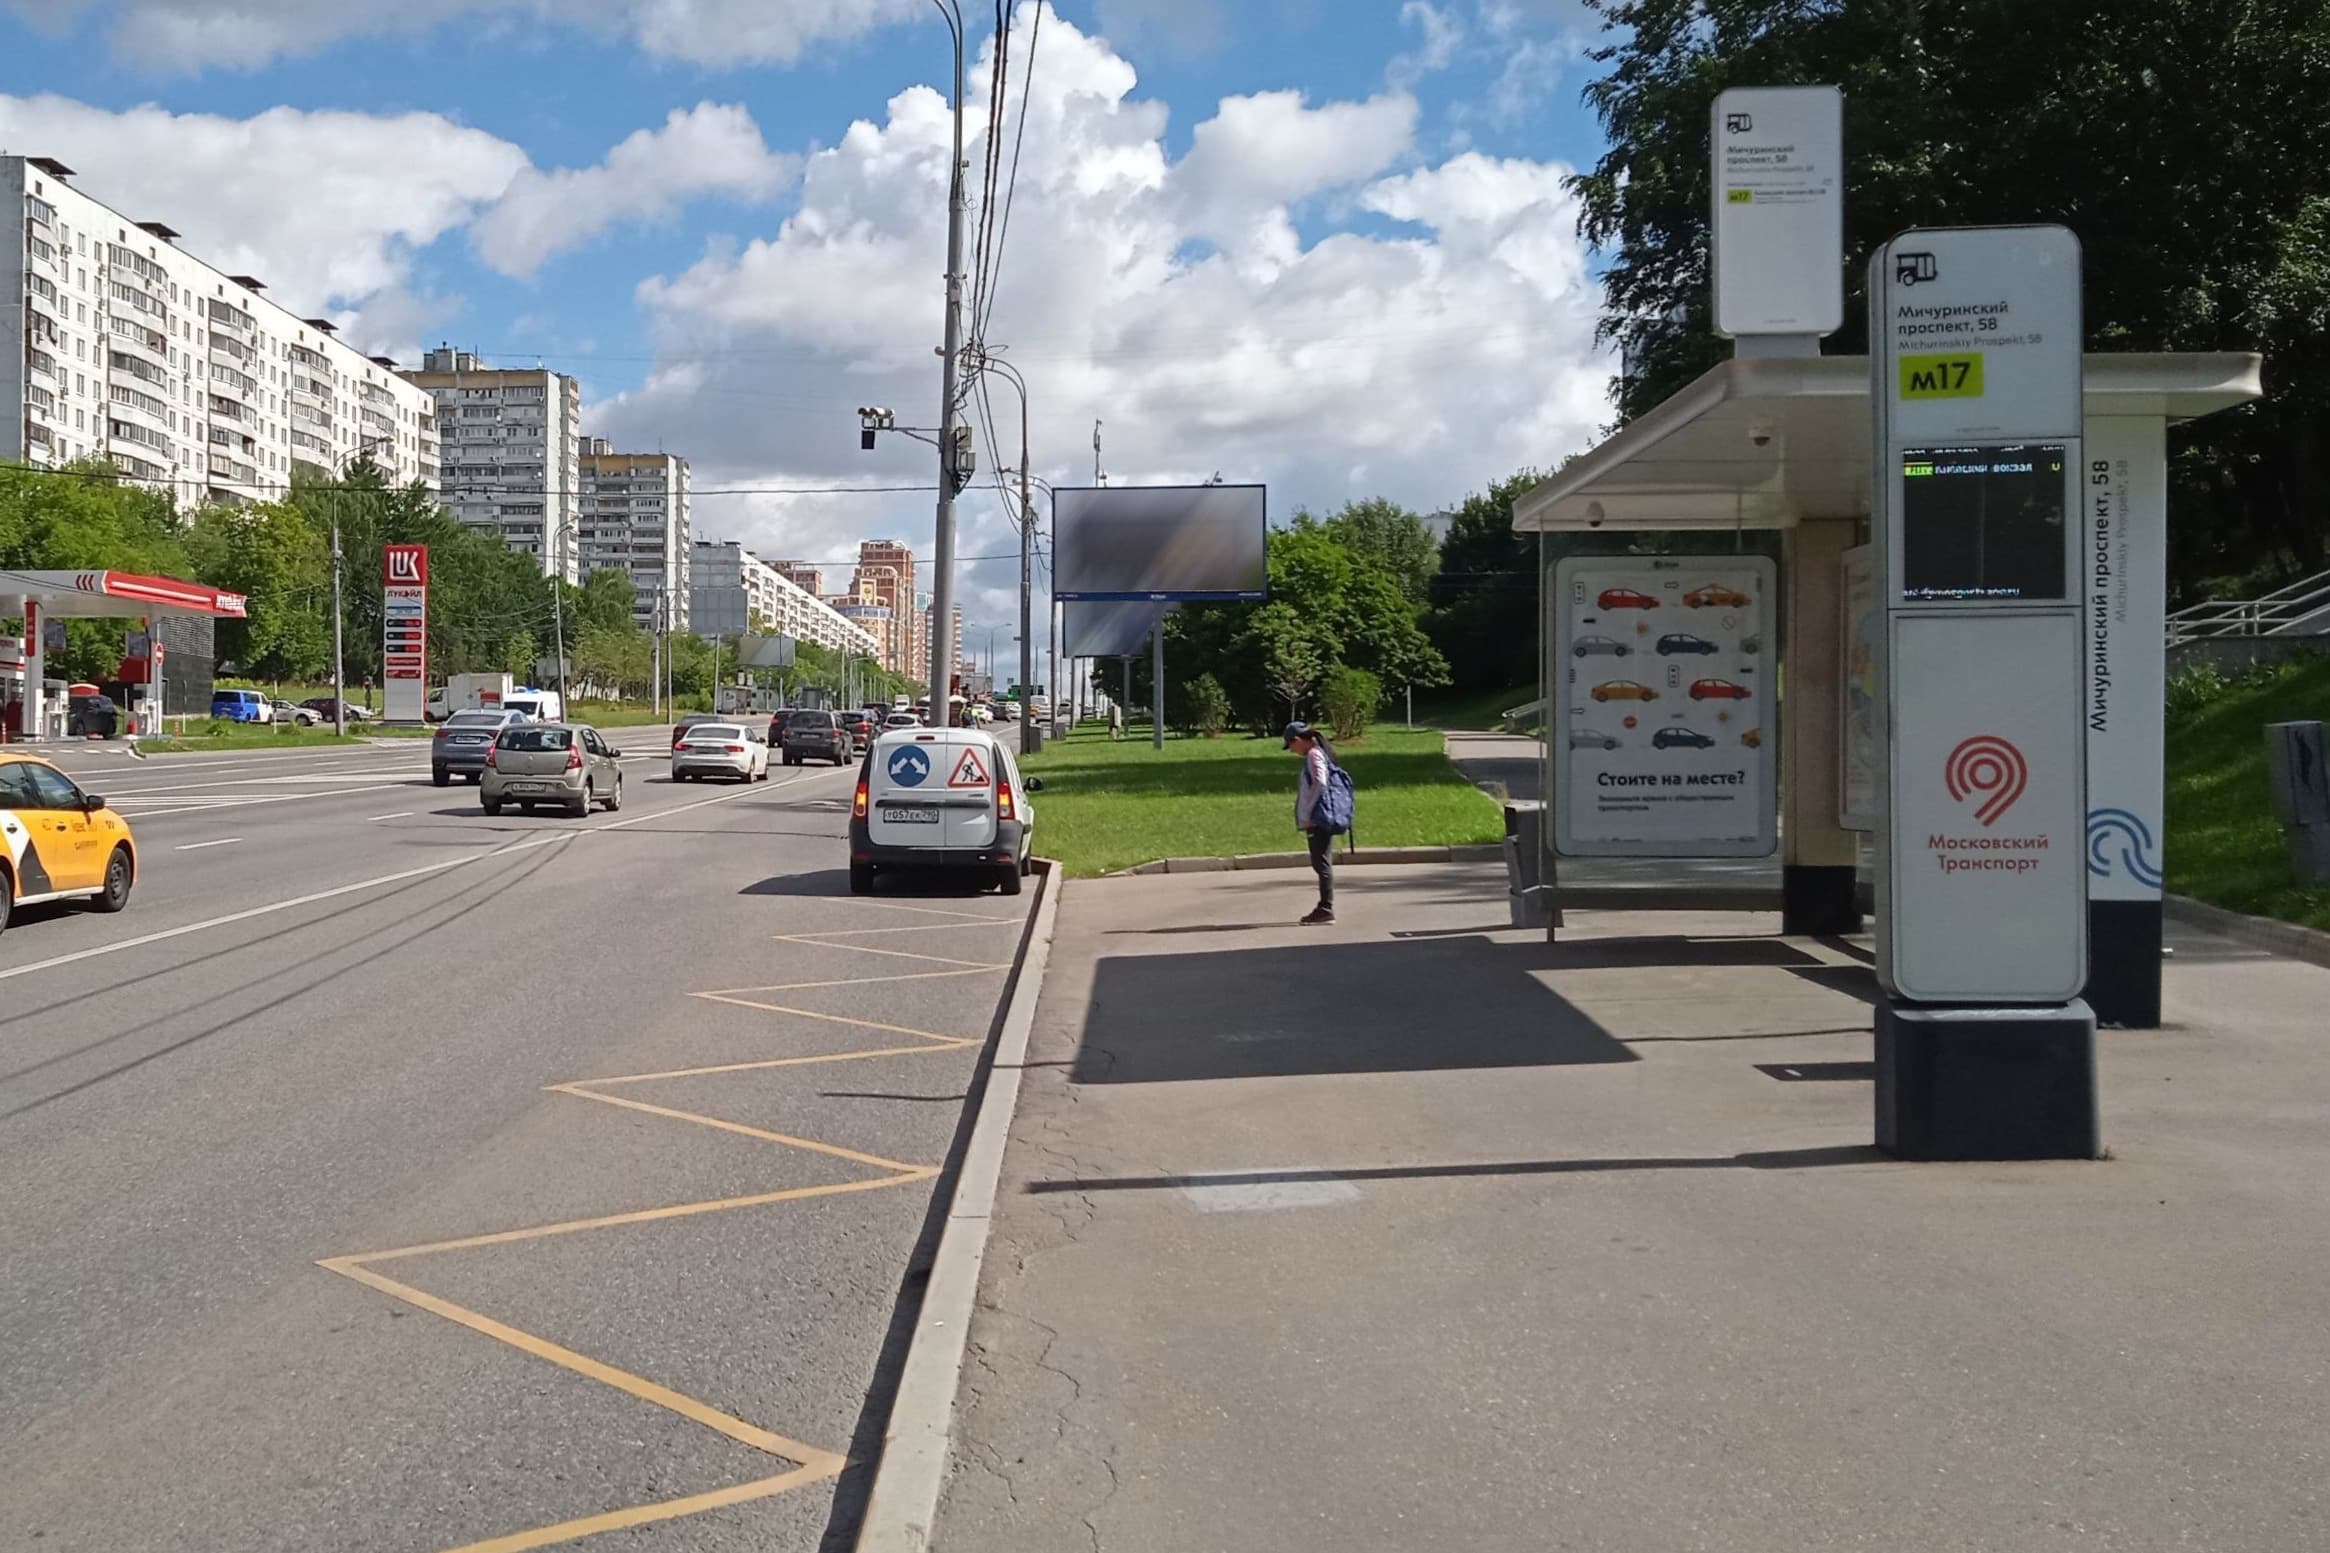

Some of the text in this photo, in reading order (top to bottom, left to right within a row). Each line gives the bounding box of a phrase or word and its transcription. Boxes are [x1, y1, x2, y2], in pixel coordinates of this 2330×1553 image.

[1898, 301, 2009, 319] Мичуринский
[1898, 317, 1998, 336] проспект, 58
[2027, 333, 2043, 345] 58
[2090, 460, 2112, 732] Мичуринский проспект, 58
[1597, 770, 1745, 786] Стоите на месте?
[1928, 834, 2049, 850] Московский
[1937, 854, 2040, 874] Транспорт
